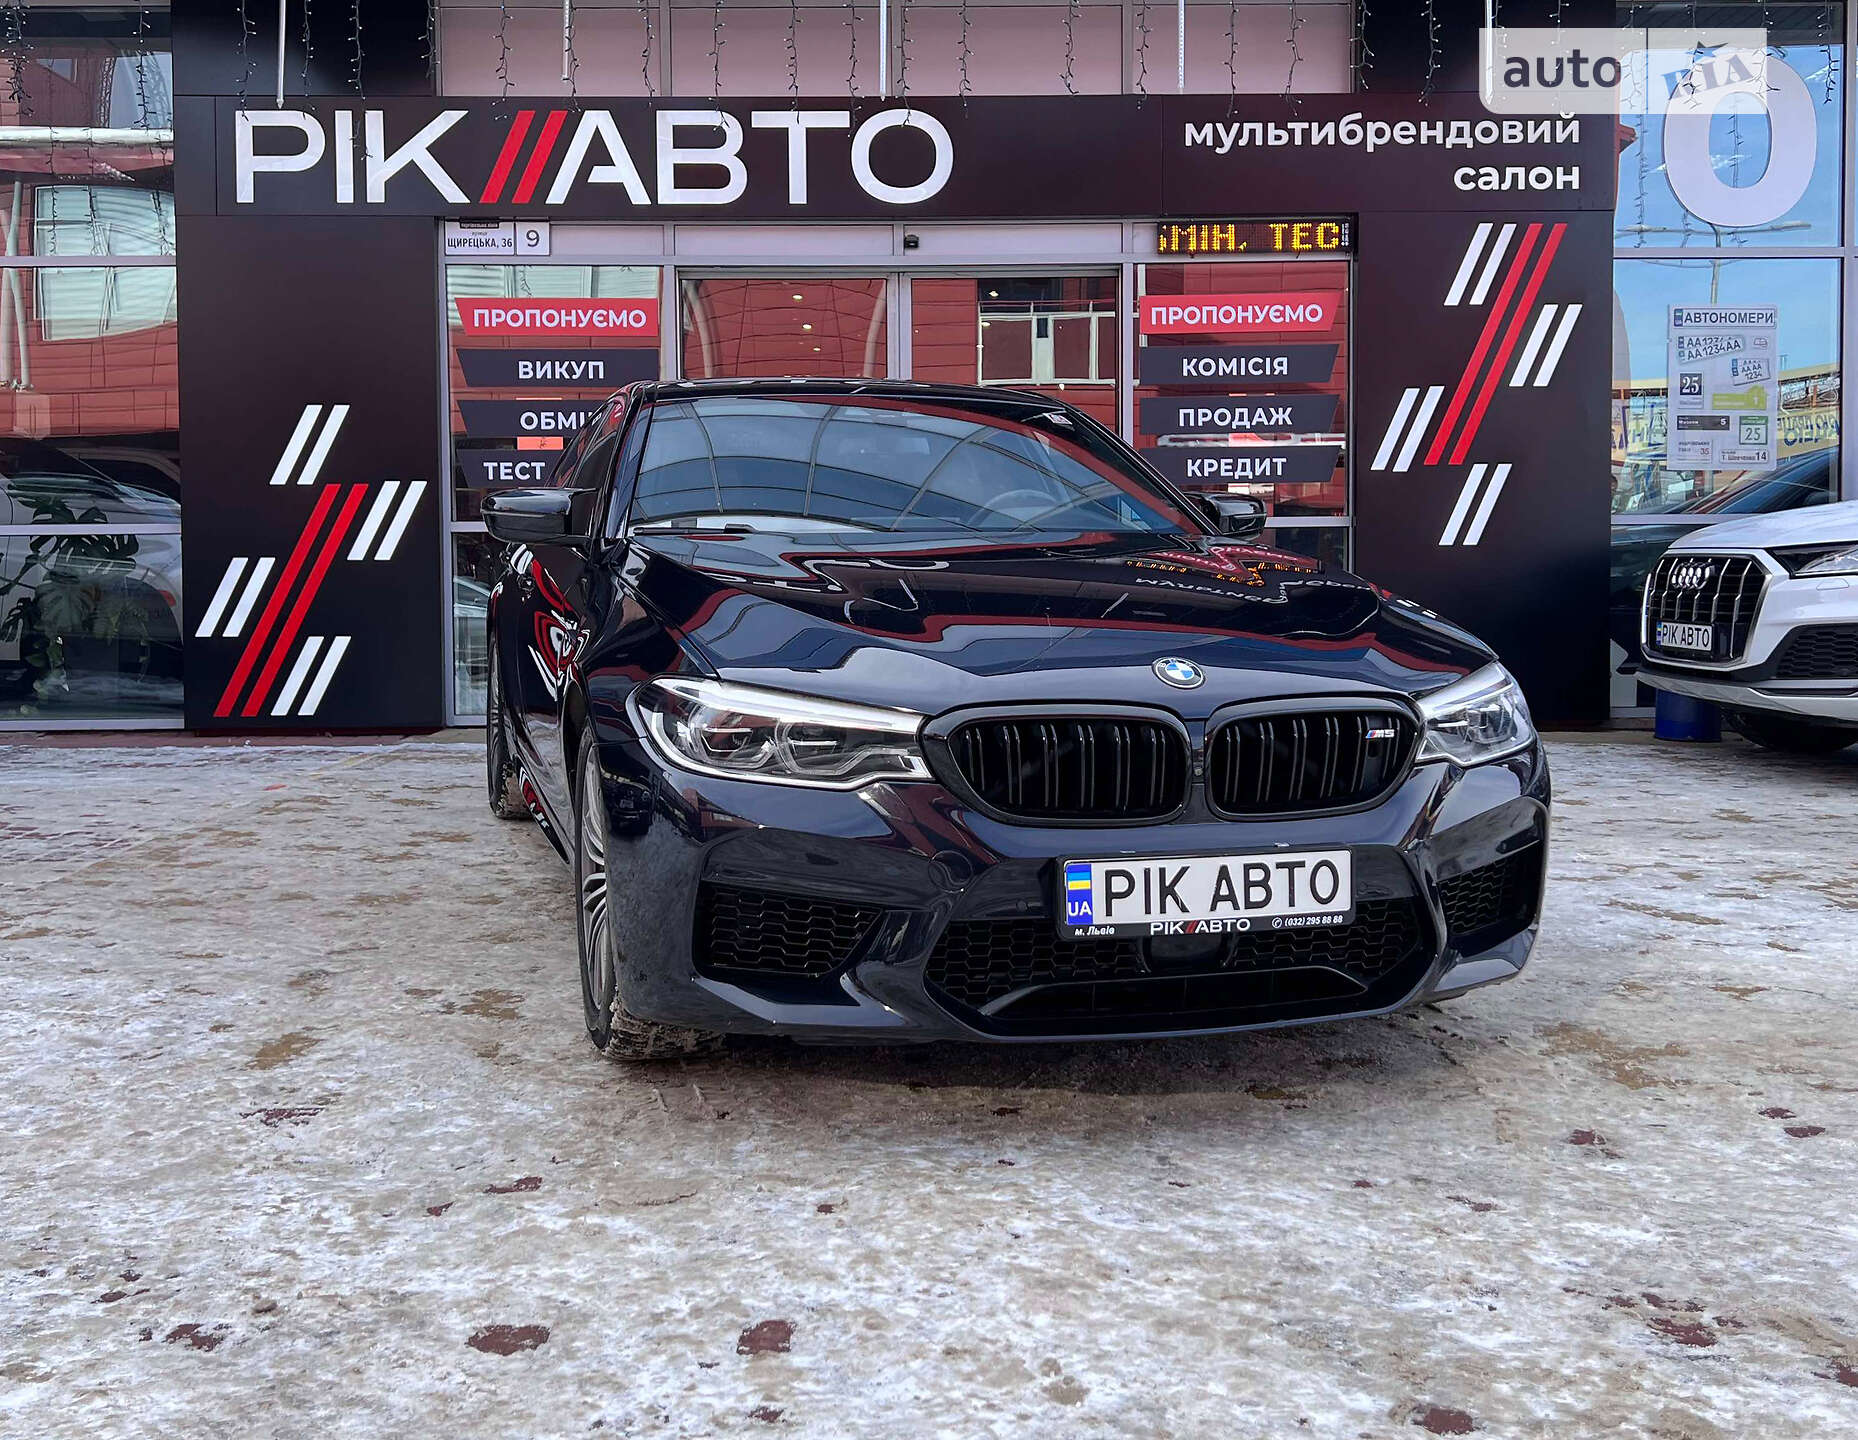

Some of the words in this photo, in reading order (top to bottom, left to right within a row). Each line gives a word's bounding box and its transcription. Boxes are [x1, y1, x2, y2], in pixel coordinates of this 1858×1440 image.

[1184, 112, 1580, 153] мультибрендовий
[1453, 165, 1580, 190] салон
[447, 238, 499, 249] ЩИРЕЦЬКА,
[501, 238, 513, 248] 36
[525, 229, 540, 248] 9
[473, 309, 647, 327] ПРОПОНУЄМО
[1151, 304, 1323, 325] ПРОПОНУЄМО
[1684, 313, 1774, 324] АВТОНОМЕРИ
[518, 361, 604, 379] ВИКУП
[1182, 357, 1288, 376] КОМІСІЯ
[1682, 376, 1700, 394] 25
[1179, 408, 1292, 428] ПРОДАЖ
[1745, 428, 1761, 441] 25
[1756, 452, 1767, 461] 14
[483, 462, 546, 479] ТЕСТ
[1187, 458, 1287, 478] КРЕДИТ
[1067, 901, 1092, 917] UA
[1284, 918, 1305, 927] (032)
[1306, 917, 1320, 926] 295
[1322, 917, 1331, 925] 88
[1333, 915, 1344, 924] 88
